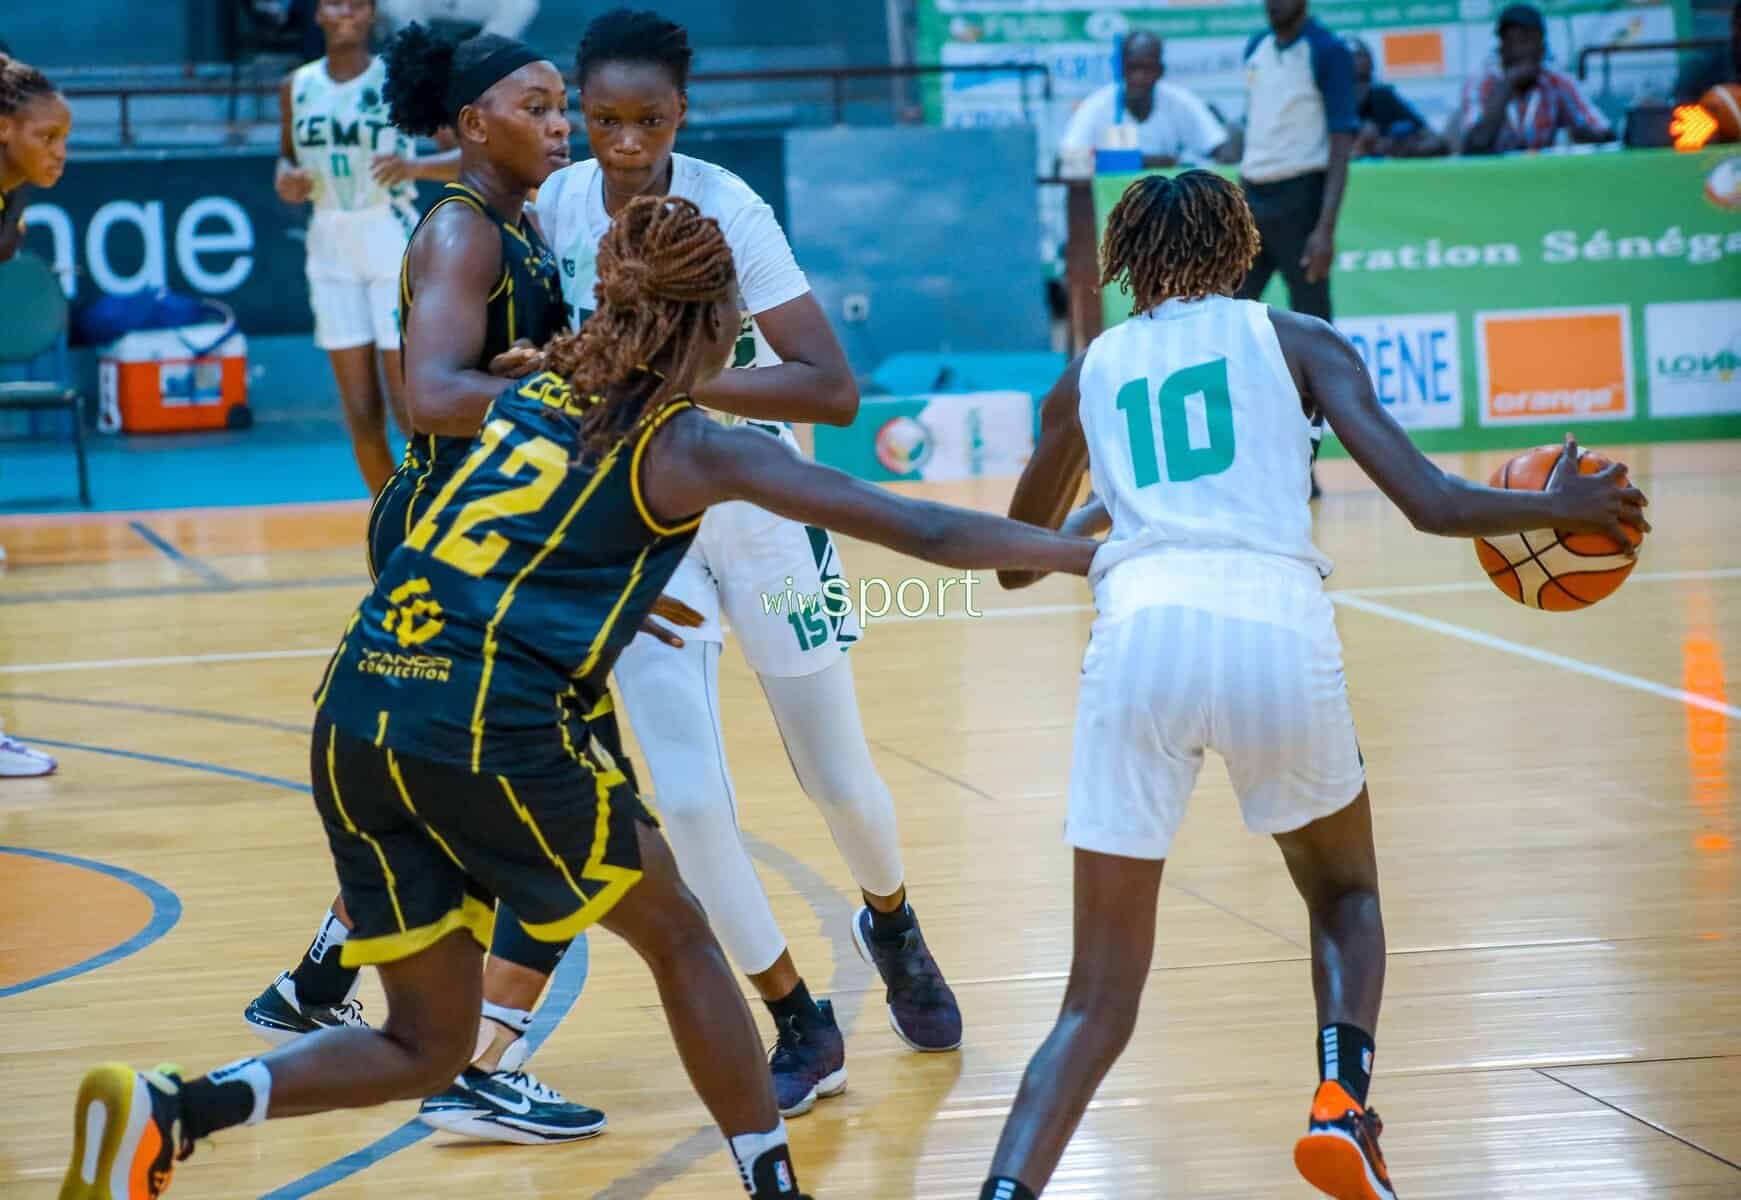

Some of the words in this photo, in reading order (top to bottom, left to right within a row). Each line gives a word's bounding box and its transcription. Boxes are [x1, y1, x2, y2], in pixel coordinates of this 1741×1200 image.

[1116, 357, 1236, 489] 10
[1493, 388, 1612, 418] orange
[404, 418, 569, 578] 12
[787, 603, 830, 652] 15
